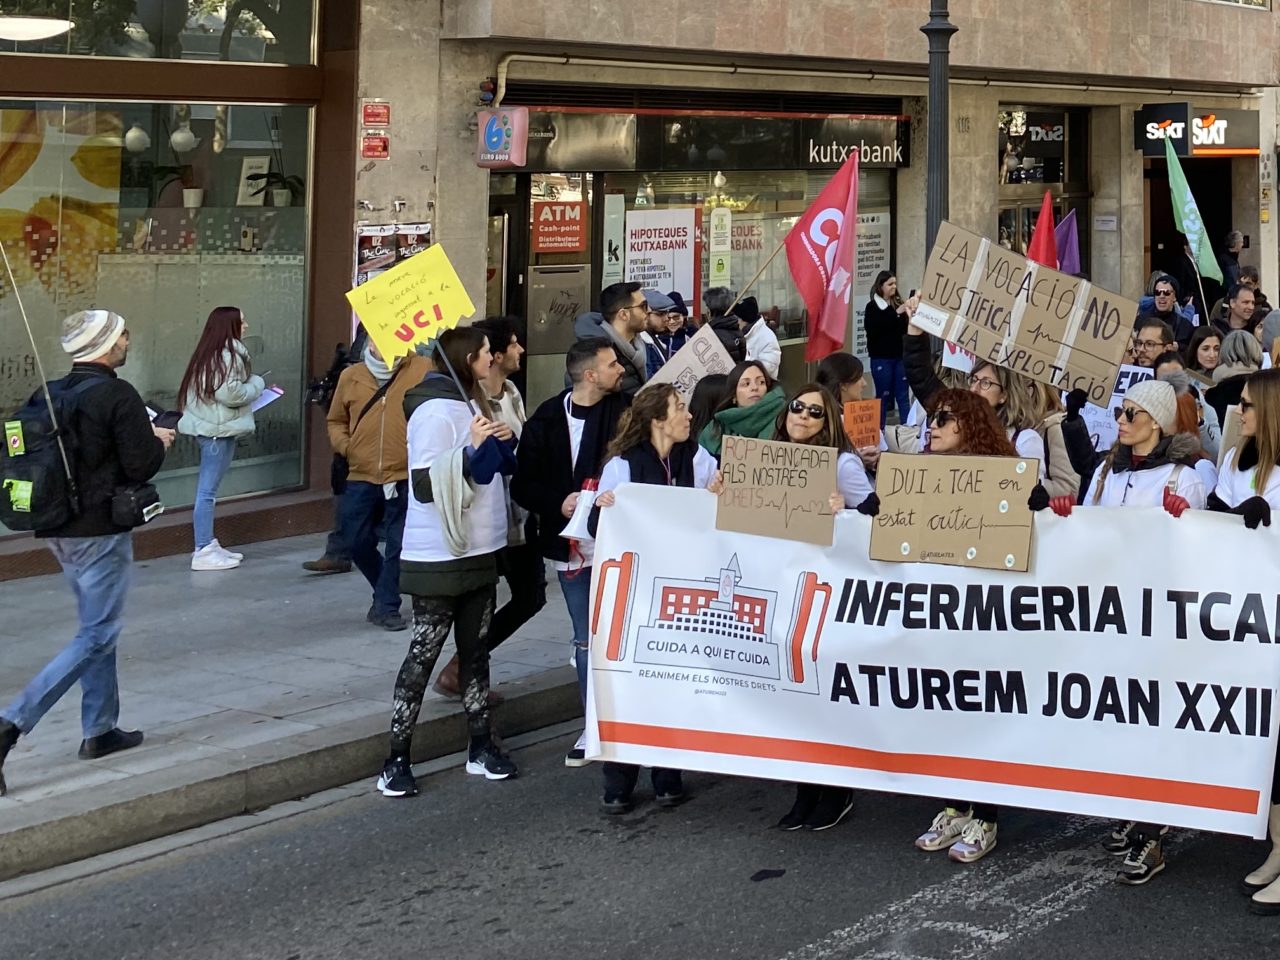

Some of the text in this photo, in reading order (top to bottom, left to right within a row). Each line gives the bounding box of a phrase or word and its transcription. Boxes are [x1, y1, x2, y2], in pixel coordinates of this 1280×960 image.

[1146, 120, 1185, 139] SIXT
[1192, 114, 1228, 145] SIXT
[540, 205, 580, 221] ATM
[371, 236, 382, 246] U2
[407, 234, 418, 244] U2
[630, 227, 688, 239] HIPOTEQUES
[630, 239, 688, 252] KUTXABANK
[362, 246, 391, 260] The Cure
[399, 247, 411, 258] The
[939, 233, 1121, 341] LA VOCACIÓ NO
[394, 303, 444, 342] UCI
[957, 324, 979, 352] LA
[988, 342, 1109, 401] EXPLOTACIÓ
[725, 437, 829, 470] RCP AVANÇADA
[723, 463, 807, 488] ALS NOSTRES
[886, 467, 1023, 496] DUI i TCAE en
[723, 487, 763, 509] DRETS
[877, 504, 979, 532] estat crític
[834, 578, 1128, 635] INFERMERIA
[1141, 587, 1152, 637] I
[647, 640, 771, 666] CUIDA A QUI ET CUIDA
[638, 669, 776, 692] REANIMEM ELS NOSTRES DRETS
[830, 662, 1278, 738] ATUREM JOAN XXII
